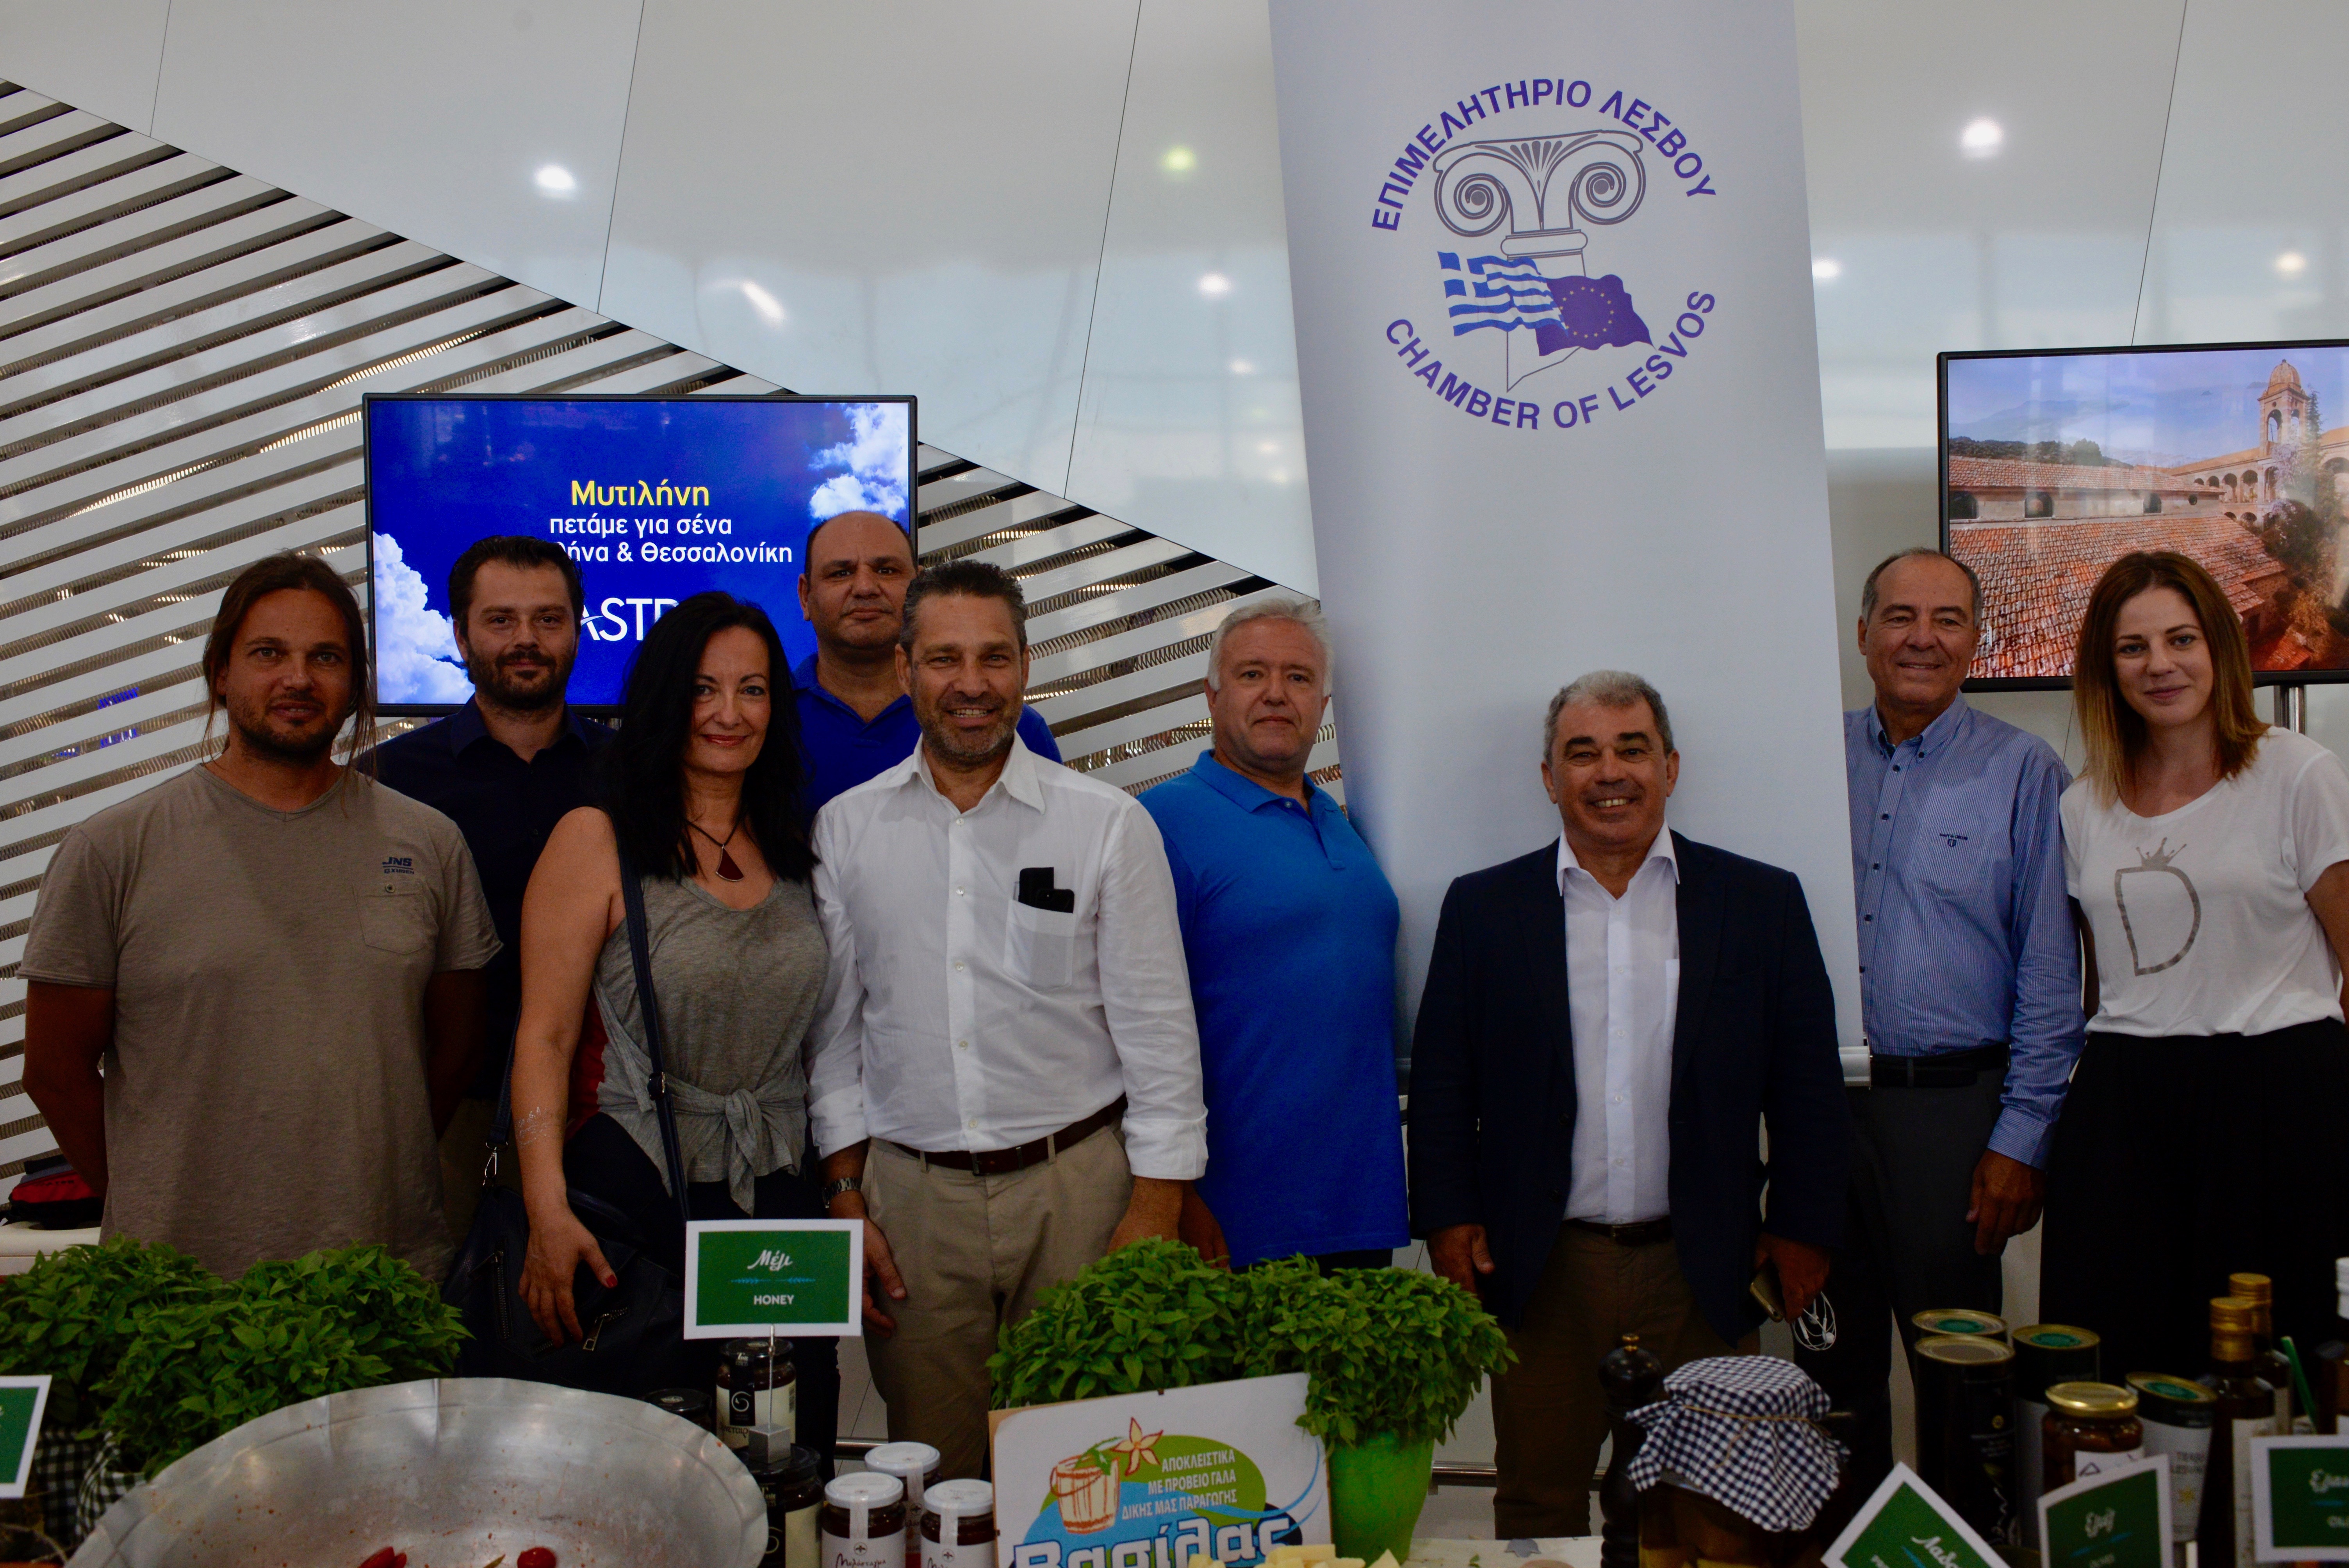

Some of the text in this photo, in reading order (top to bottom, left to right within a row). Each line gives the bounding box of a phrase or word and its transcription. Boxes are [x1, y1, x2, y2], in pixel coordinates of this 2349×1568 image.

[1372, 78, 1716, 231] ΕΠΙΜΕΛΗΤΗΡΙΟ ΛΕΣΒΟΥ
[1386, 291, 1715, 430] CHAMBER OF LESVOS
[571, 479, 709, 506] Μυτιλήνη
[550, 513, 732, 538] πετάμε για σένα
[557, 541, 792, 562] ήνα & Θεσσαλονίκη
[382, 857, 413, 866] JNS
[754, 1294, 794, 1305] HONEY
[1162, 1449, 1235, 1472] ΑΠΟΚΛΕΙΣΤΙΚΑ
[1148, 1469, 1236, 1495] ΜΕ ΠΡΟΒΕΙΟ ΓΑΛΑ
[1121, 1489, 1237, 1520] ΔΙΚΗΣ ΜΑΣ ΠΑΡΑΓΩΓΗΣ
